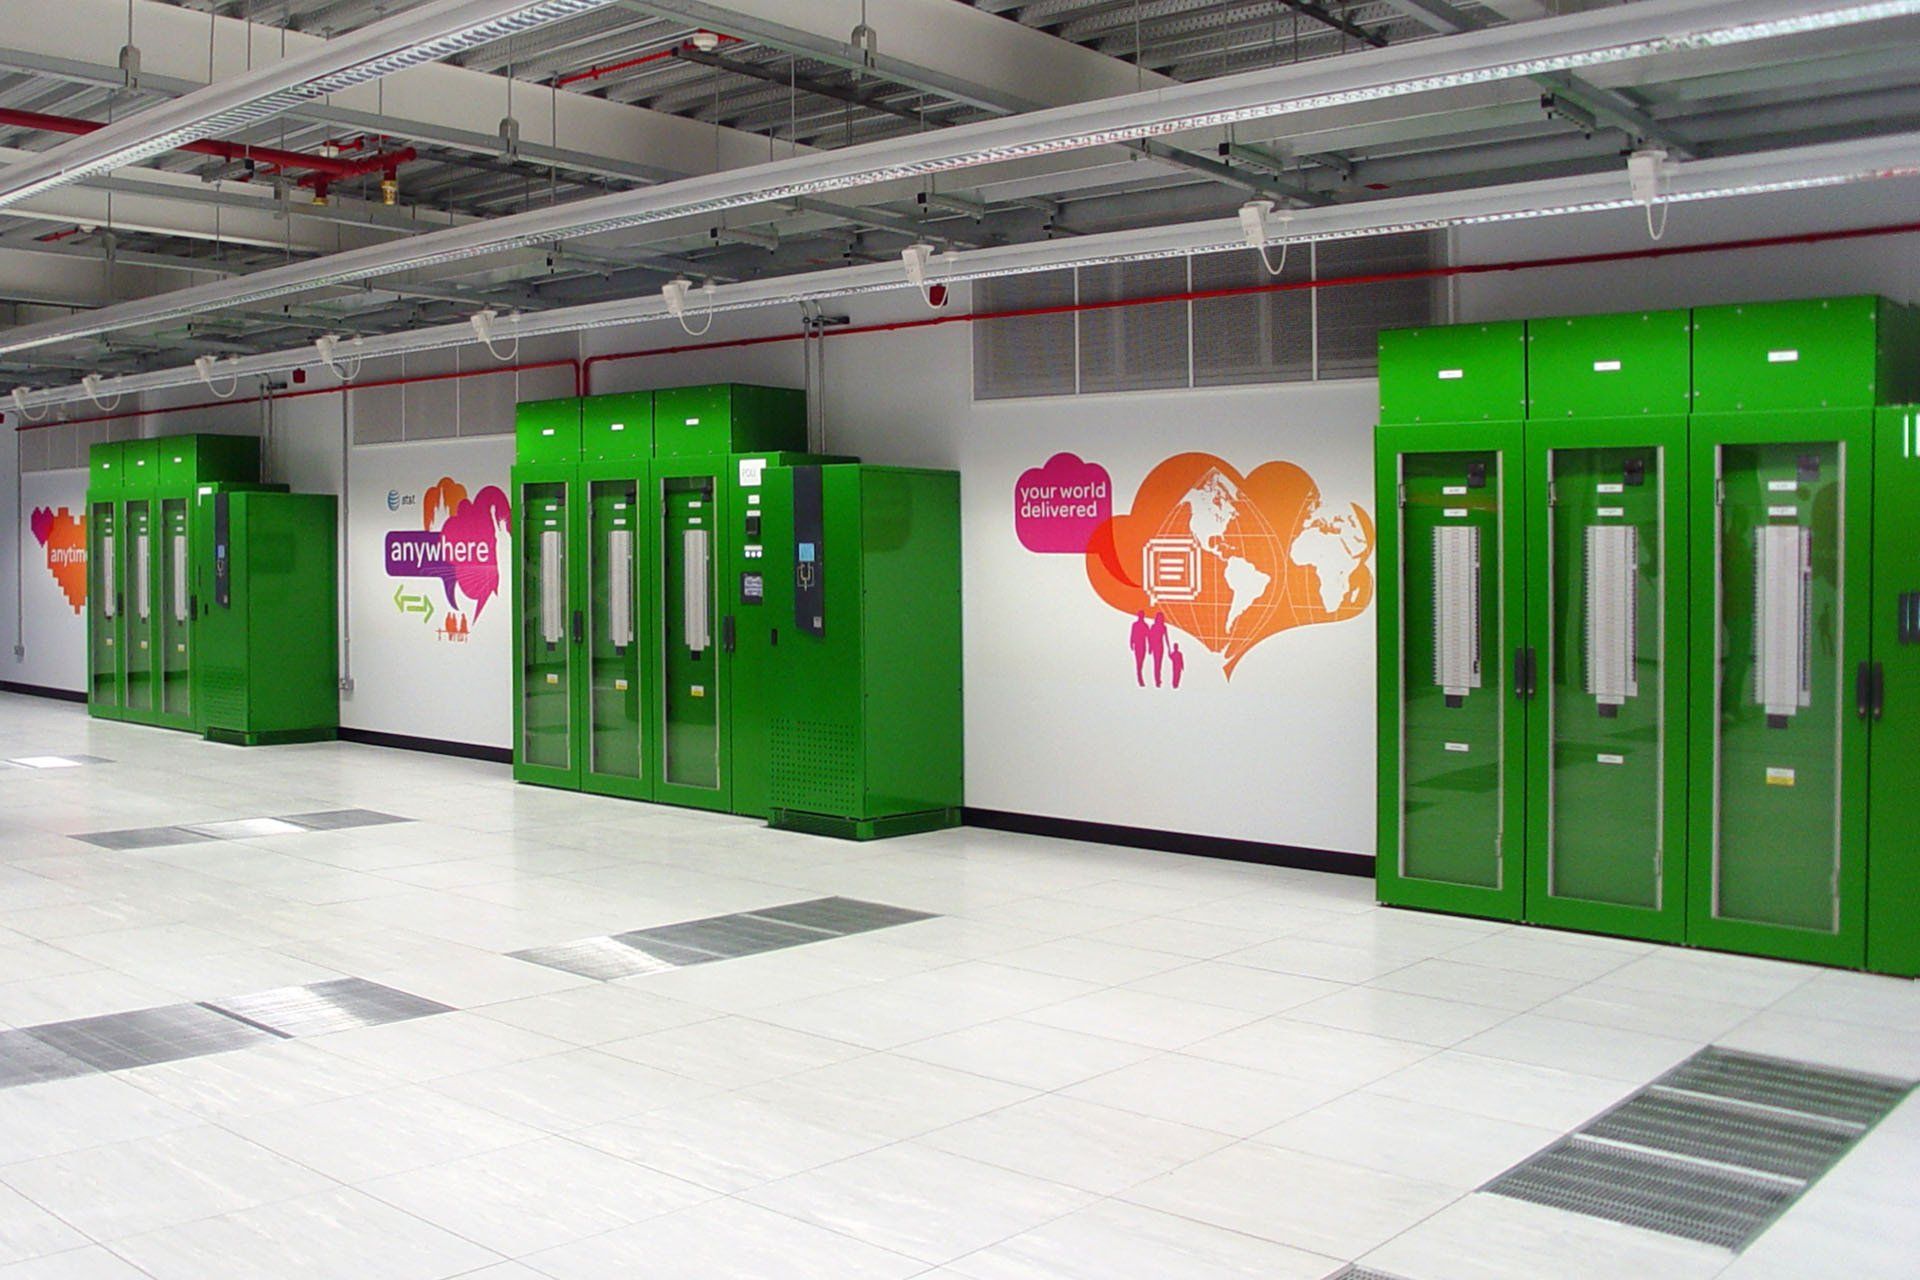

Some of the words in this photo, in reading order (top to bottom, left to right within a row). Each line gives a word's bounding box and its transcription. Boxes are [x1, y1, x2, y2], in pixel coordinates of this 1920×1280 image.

[1020, 486, 1057, 503] your
[1059, 481, 1106, 499] world
[1020, 500, 1097, 518] delivered
[391, 534, 489, 569] anywhere
